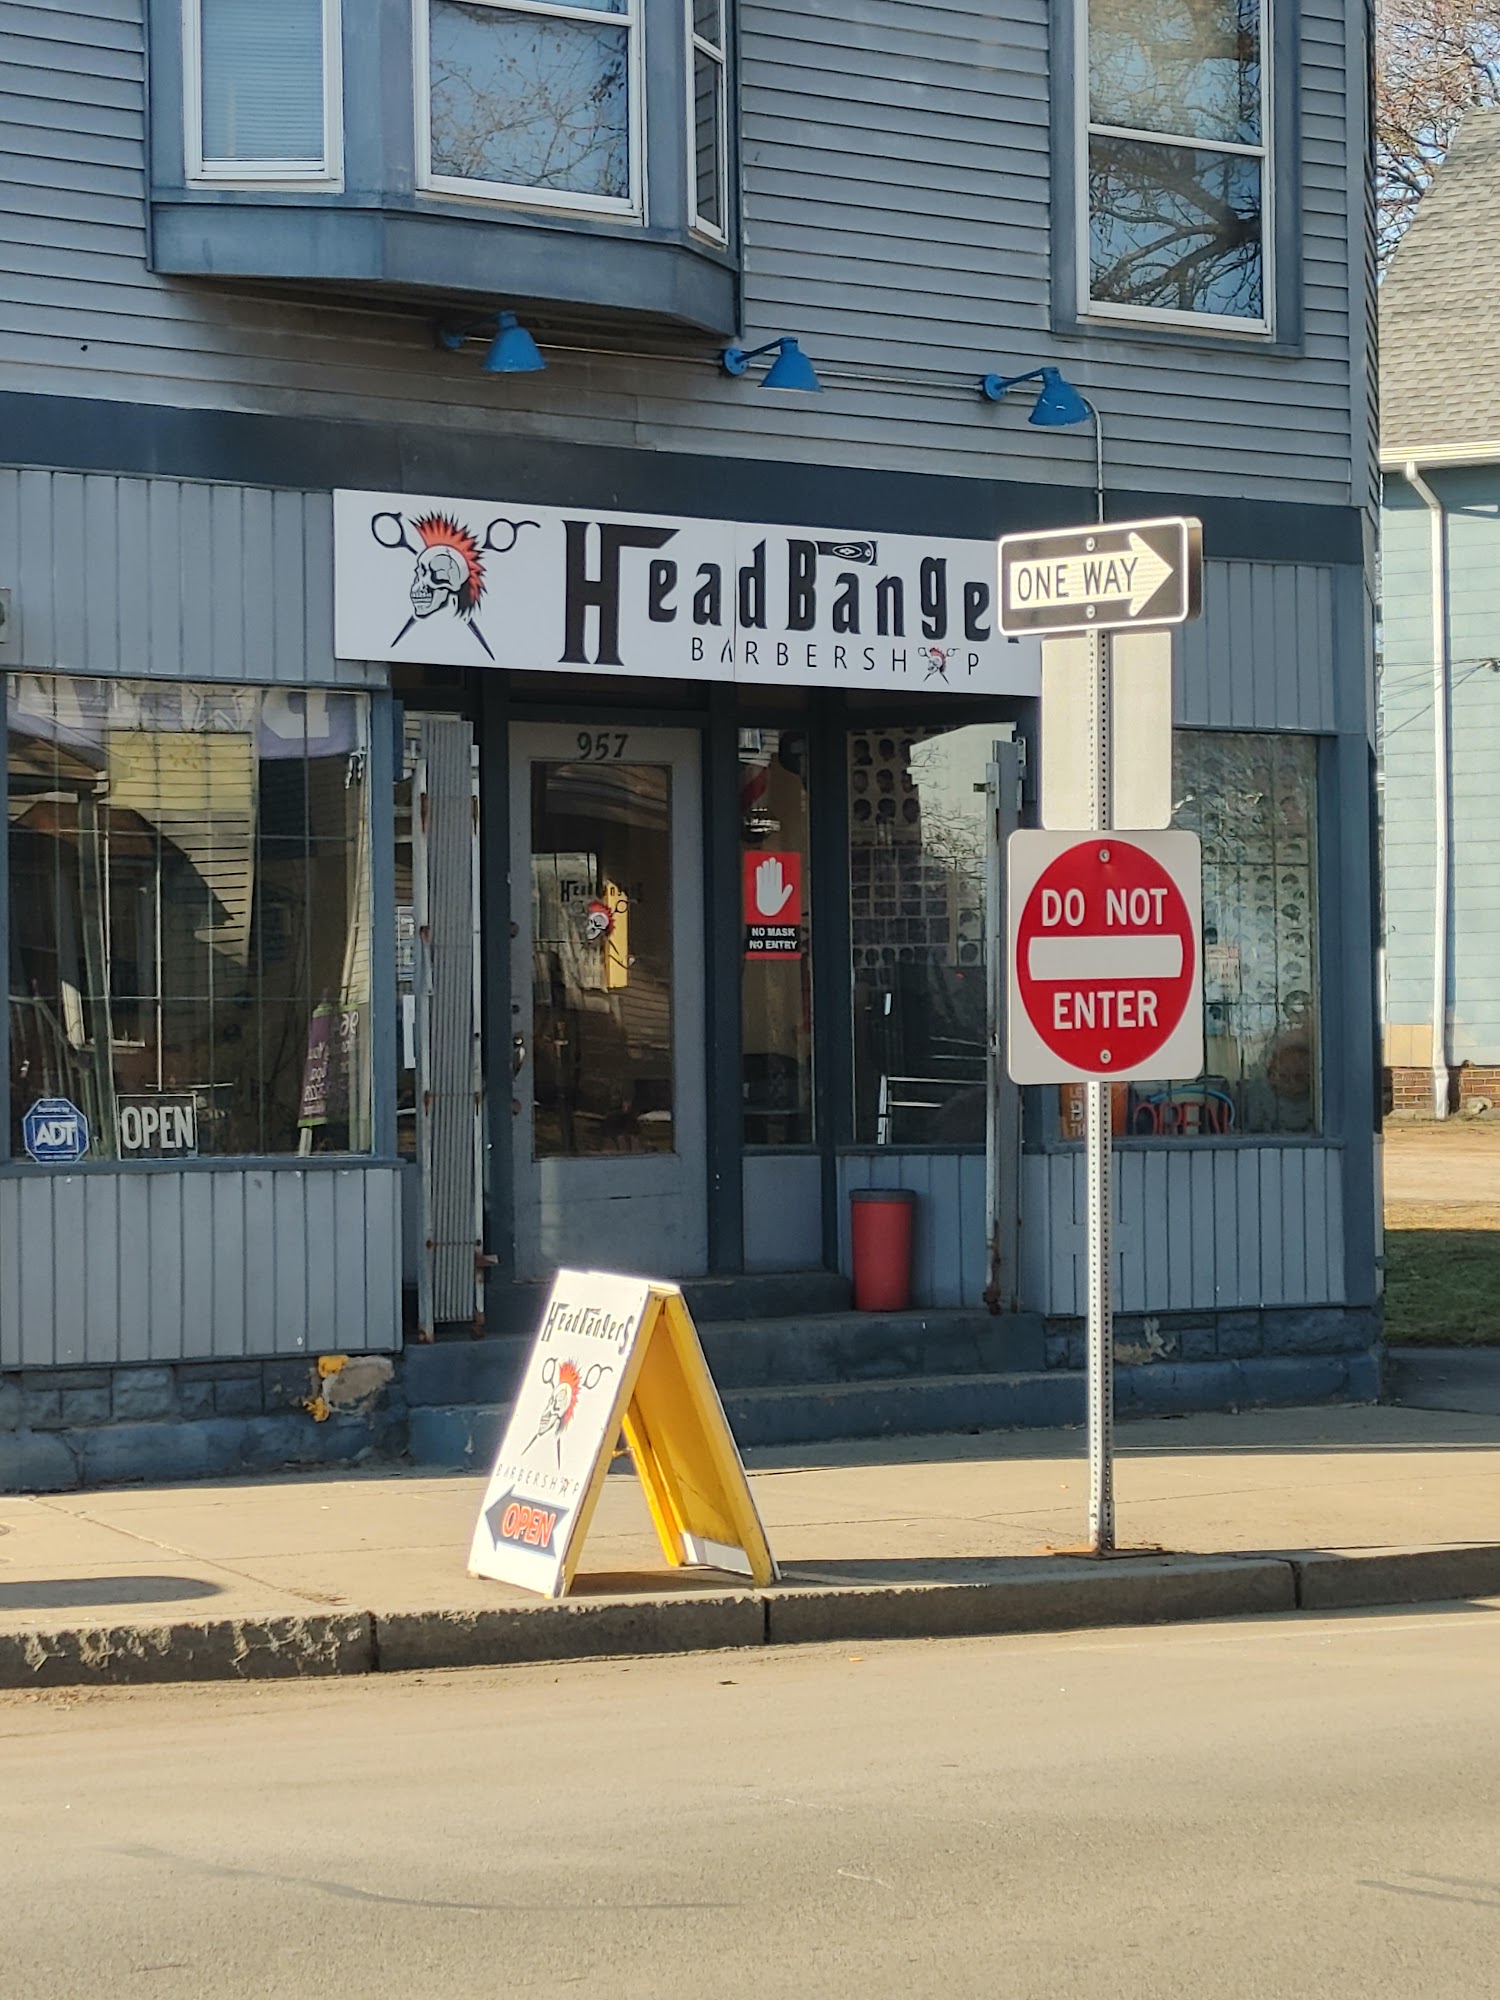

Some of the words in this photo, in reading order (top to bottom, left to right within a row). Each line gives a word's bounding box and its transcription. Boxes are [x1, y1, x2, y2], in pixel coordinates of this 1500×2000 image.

[558, 519, 1020, 667] HeadBange
[1017, 564, 1070, 601] ONE
[1083, 557, 1138, 596] WAY
[577, 731, 629, 761] 957
[1041, 887, 1086, 928] DO
[1106, 887, 1167, 927] NOT
[749, 940, 763, 949] NO
[765, 940, 797, 950] ENTRY
[751, 927, 765, 937] NO
[767, 927, 795, 937] MASK
[1053, 989, 1158, 1031] ENTER
[35, 1121, 77, 1147] ADT
[121, 1106, 194, 1150] OPEN
[502, 1502, 557, 1548] OPEN
